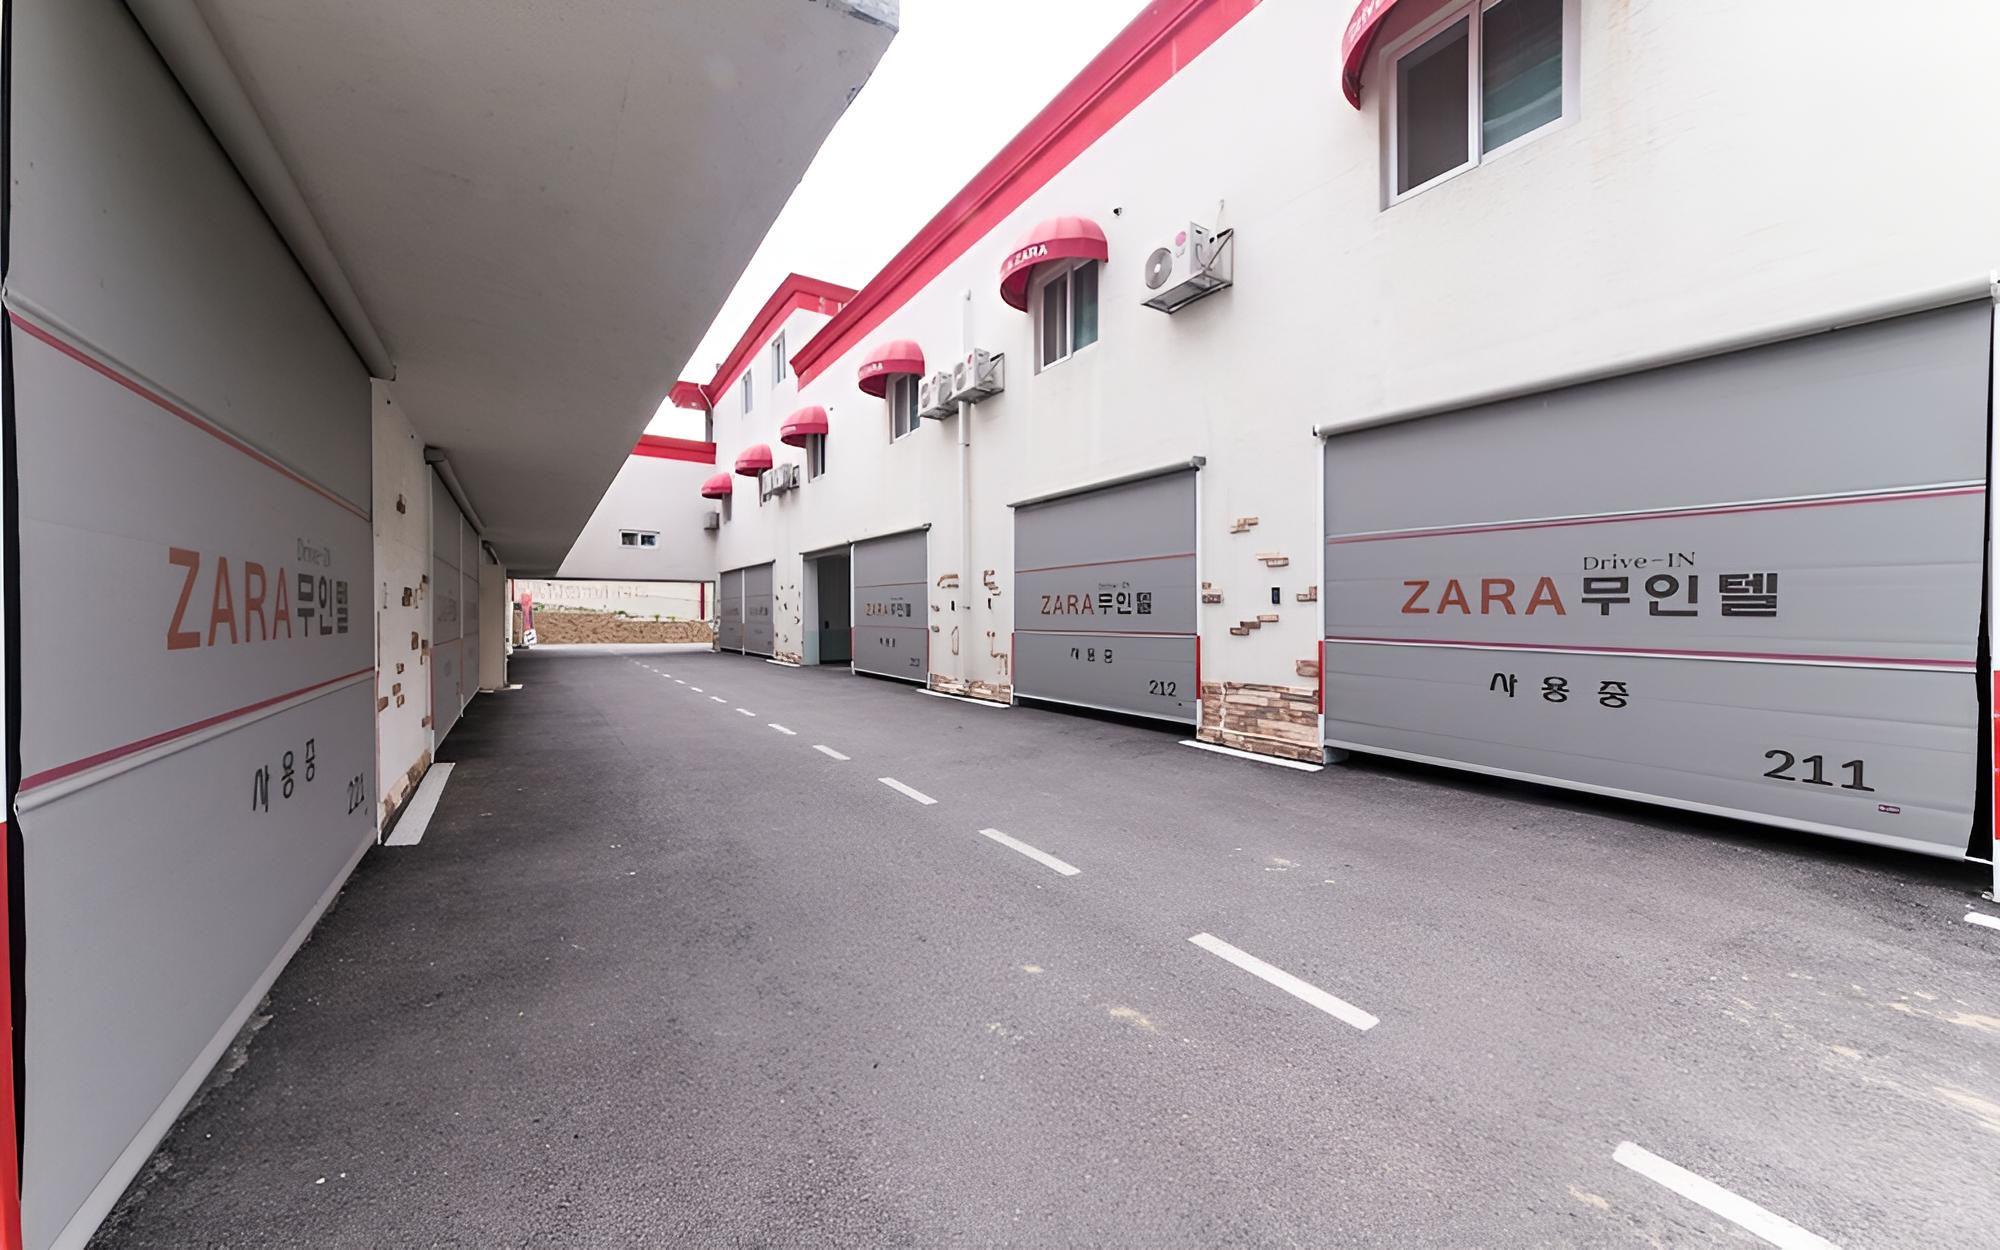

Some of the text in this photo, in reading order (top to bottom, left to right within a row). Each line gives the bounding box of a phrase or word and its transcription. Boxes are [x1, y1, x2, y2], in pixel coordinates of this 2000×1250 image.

[1583, 551, 1696, 571] Drive-IN
[167, 546, 293, 650] ZARA
[1041, 593, 1094, 615] ZARA
[1401, 572, 1778, 617] ZARA 무인텔
[1149, 680, 1176, 697] 212
[1763, 749, 1876, 793] 211
